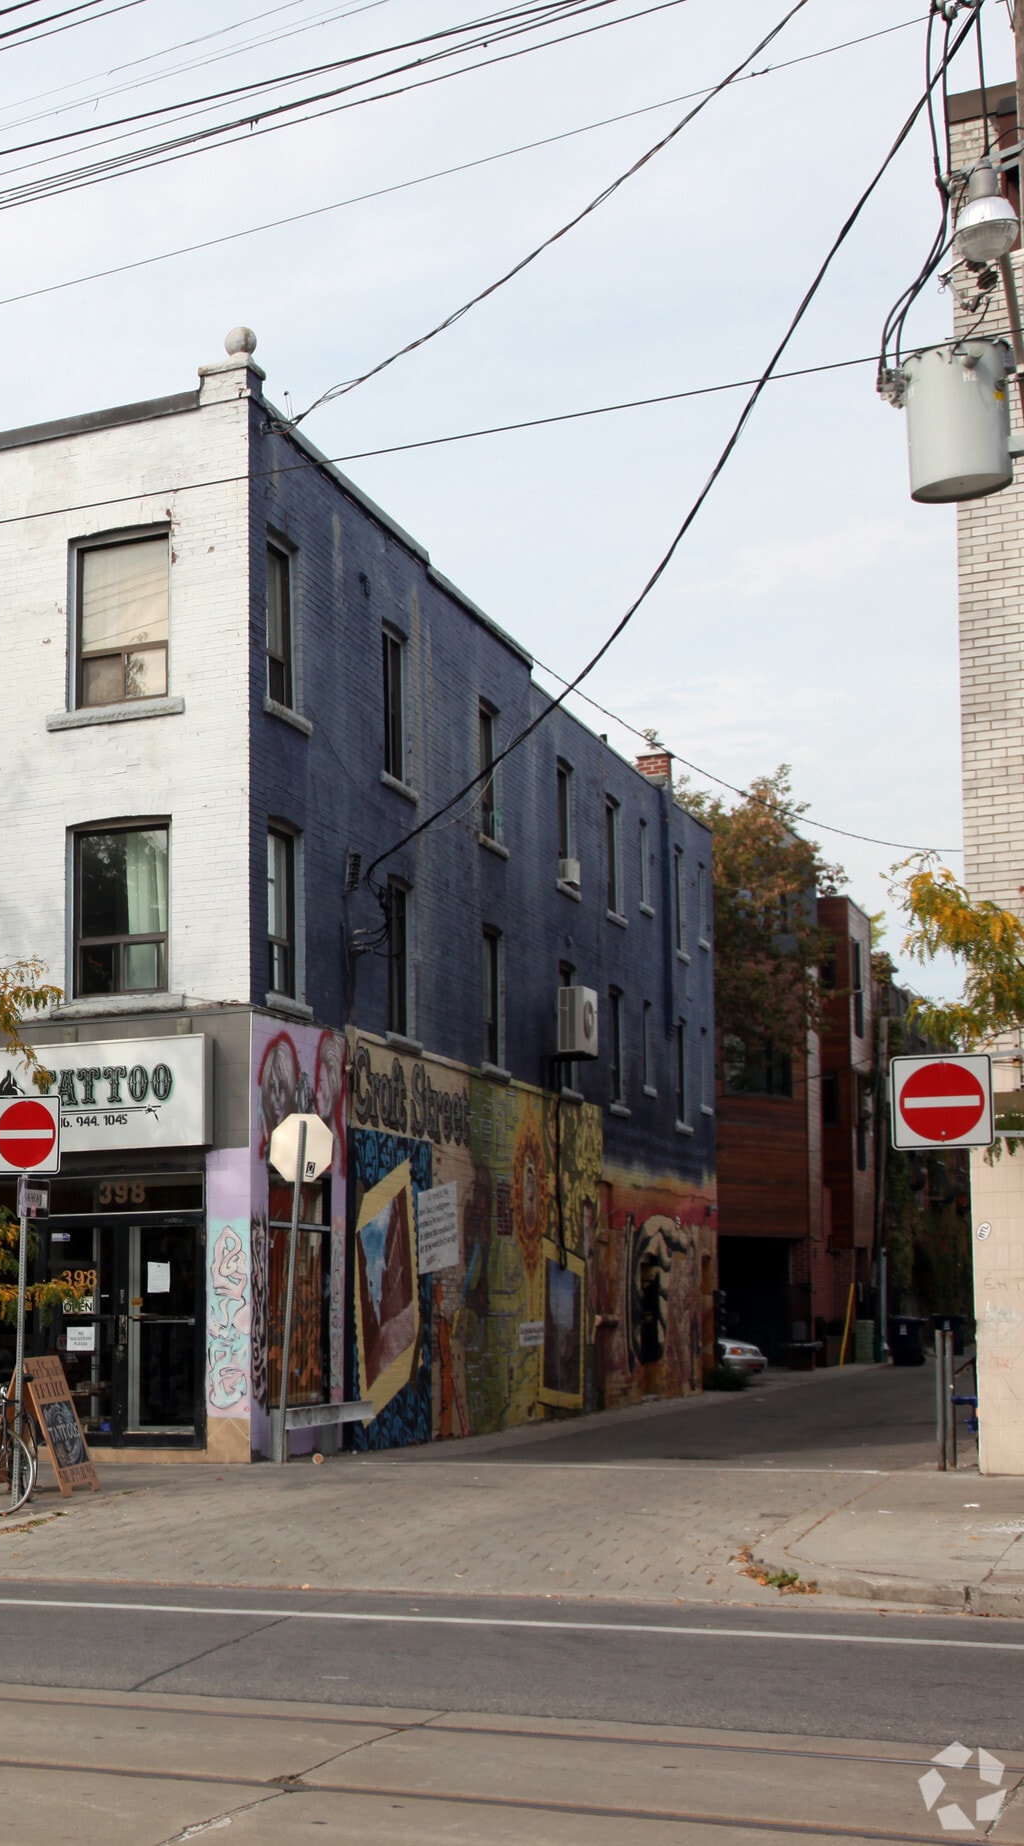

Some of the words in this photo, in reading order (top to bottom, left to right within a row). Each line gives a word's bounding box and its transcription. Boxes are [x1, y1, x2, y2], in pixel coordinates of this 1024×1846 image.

[962, 371, 977, 382] H2
[355, 1045, 407, 1134] Croft
[410, 1063, 471, 1147] Street
[104, 1114, 128, 1126] 1045
[98, 1180, 146, 1205] 398
[62, 1269, 97, 1288] 398
